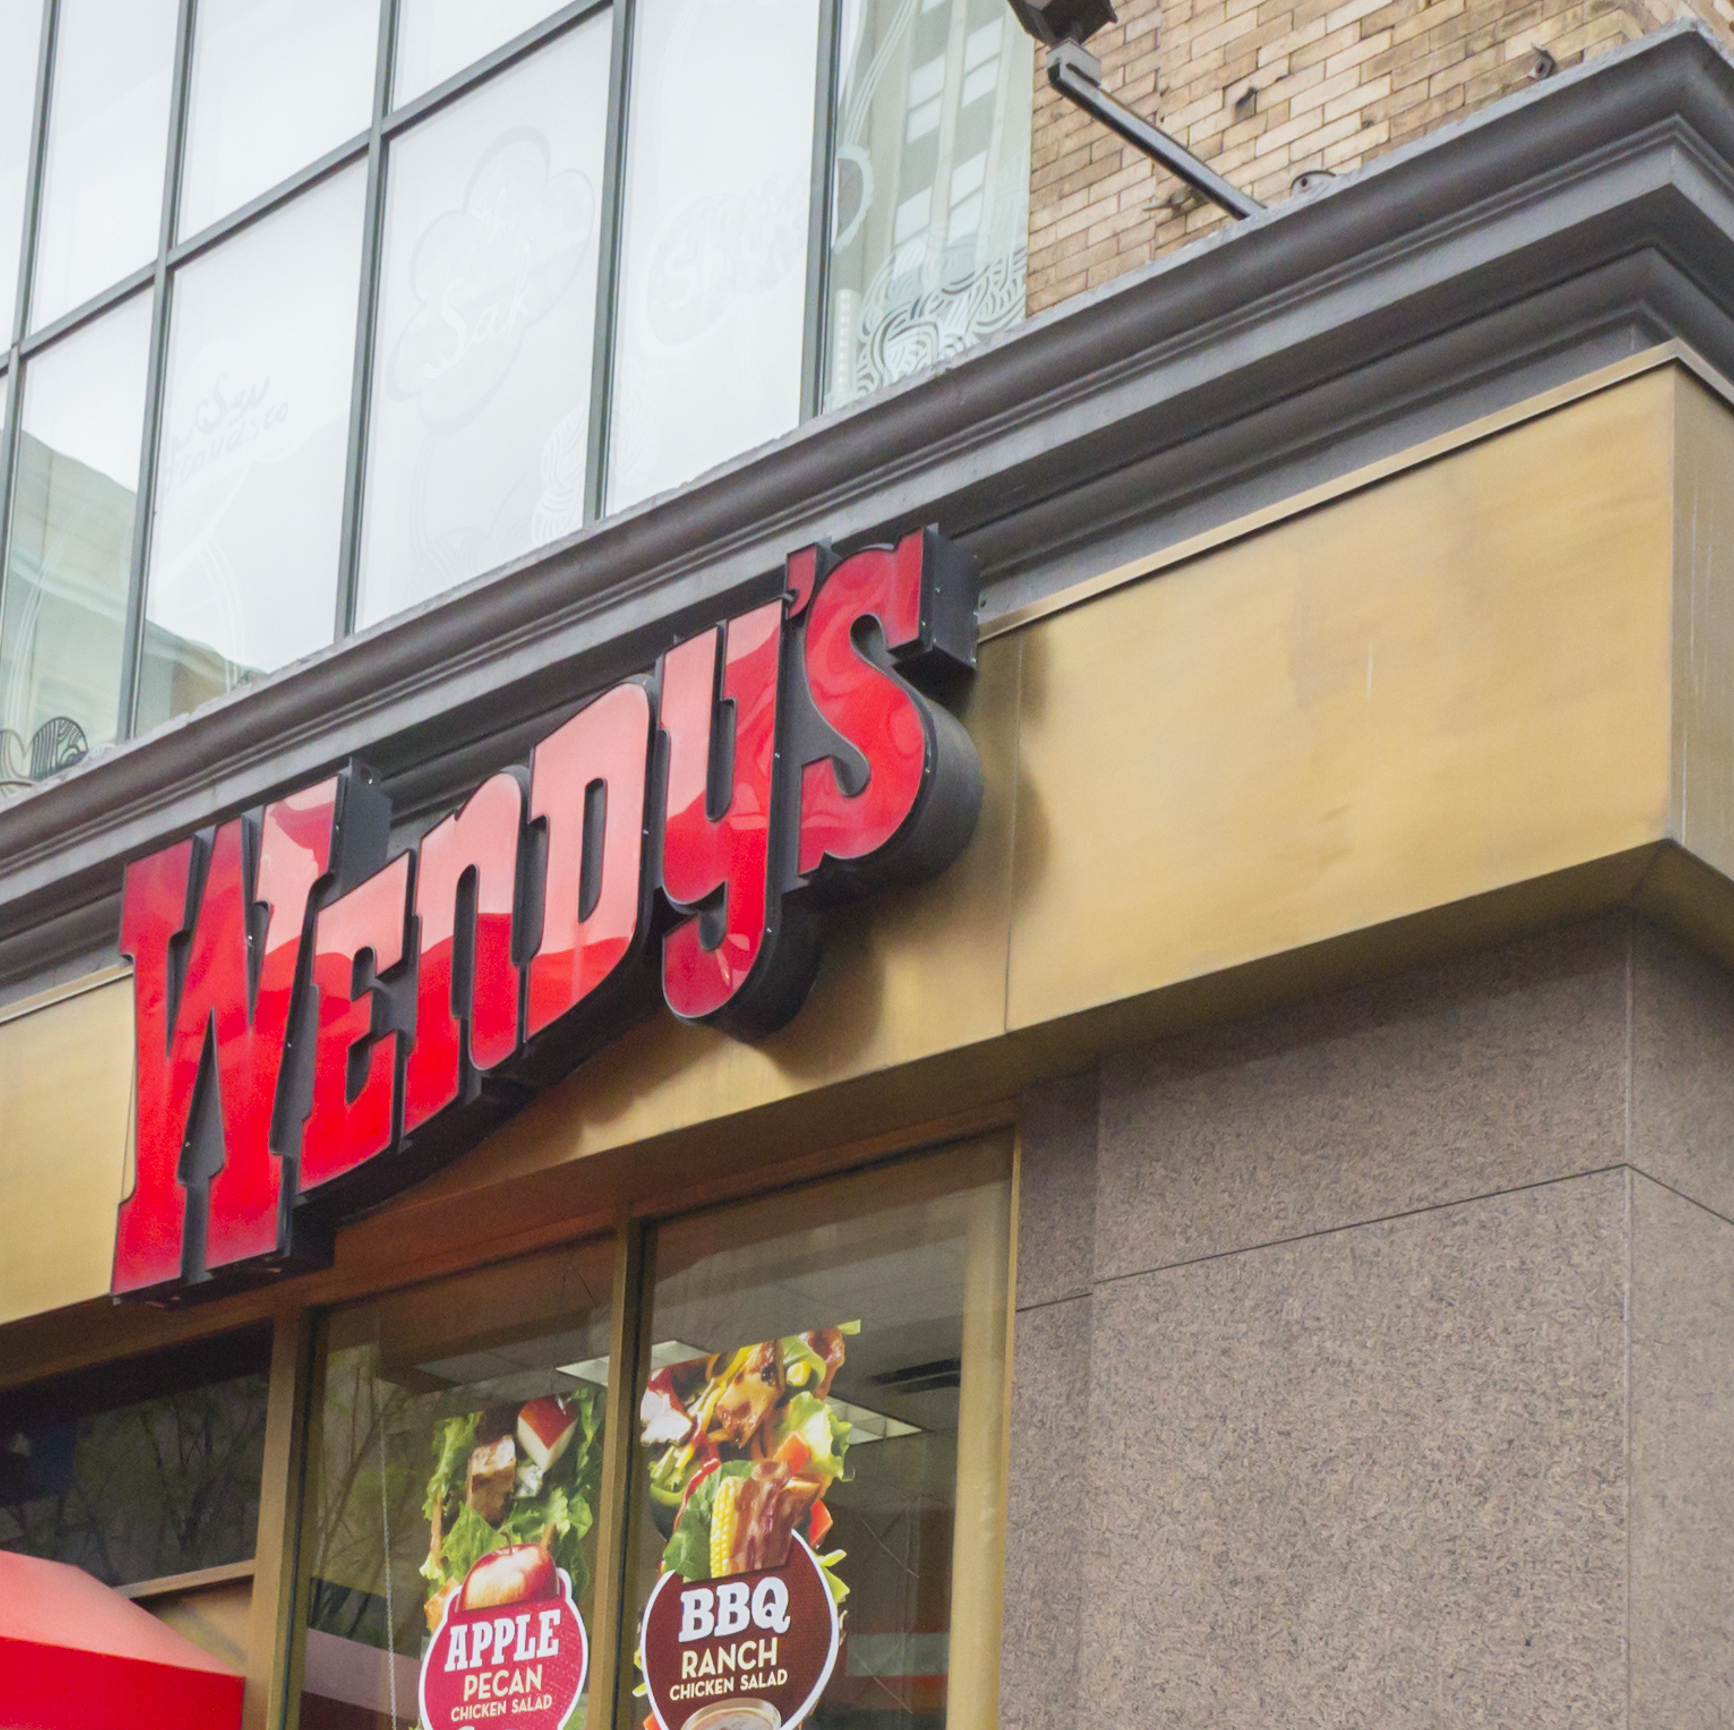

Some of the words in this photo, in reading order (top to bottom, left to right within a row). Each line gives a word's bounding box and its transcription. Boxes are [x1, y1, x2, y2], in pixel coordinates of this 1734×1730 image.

[678, 1576, 790, 1643] BBQ
[444, 1609, 561, 1672] APPLE
[681, 1637, 778, 1679] RANCH
[463, 1664, 543, 1701] PECAN
[669, 1677, 735, 1701] CHICKEN
[740, 1669, 788, 1691] SALAD
[450, 1701, 507, 1722] CHICKEN
[511, 1694, 553, 1713] SALAD
